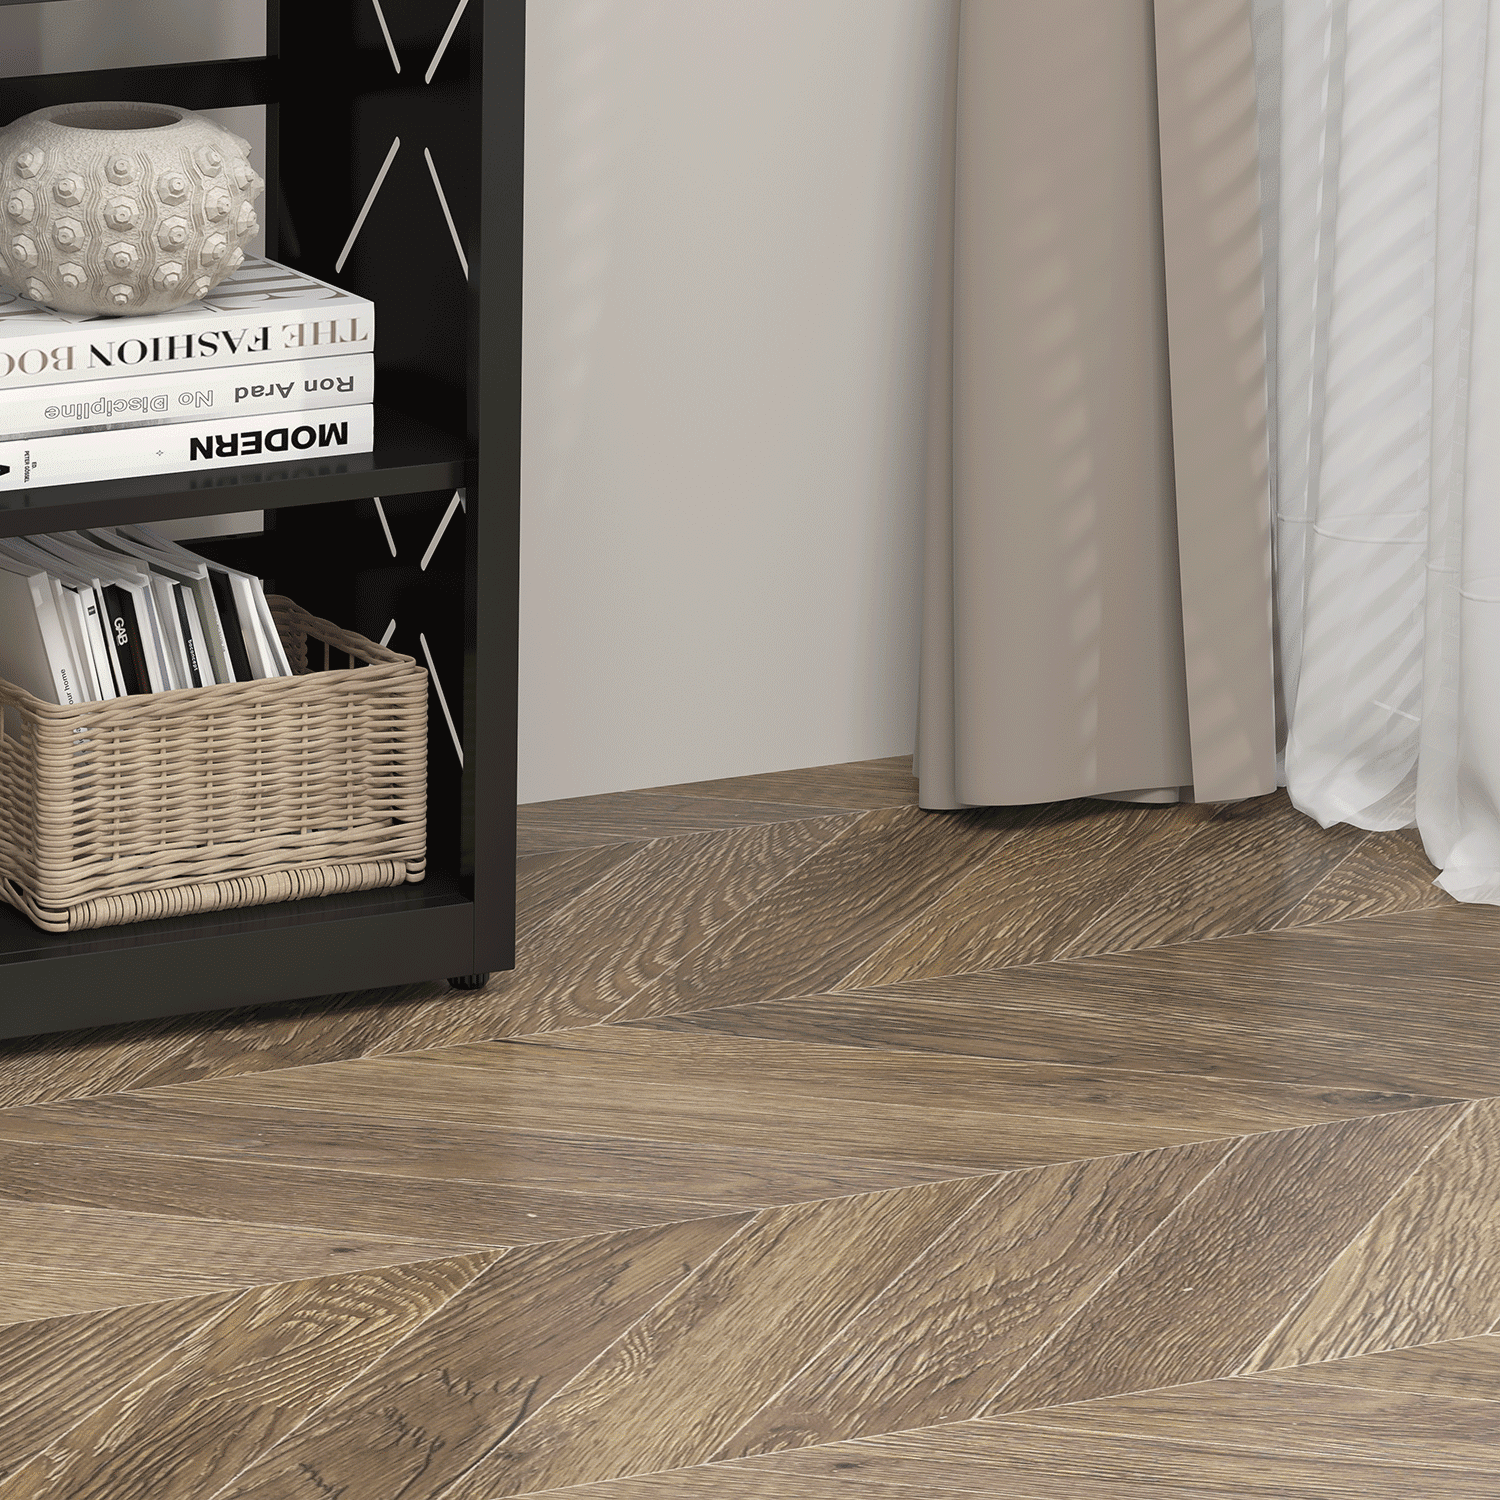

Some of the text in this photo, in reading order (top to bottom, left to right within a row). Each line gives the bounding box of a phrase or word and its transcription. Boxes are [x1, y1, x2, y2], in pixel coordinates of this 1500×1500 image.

[87, 325, 272, 369] FASHION
[282, 317, 369, 349] THE
[44, 389, 214, 420] No Discipline
[234, 376, 354, 402] Ron Arad
[189, 421, 348, 461] MODERN
[114, 617, 129, 646] GAB
[60, 668, 70, 690] home
